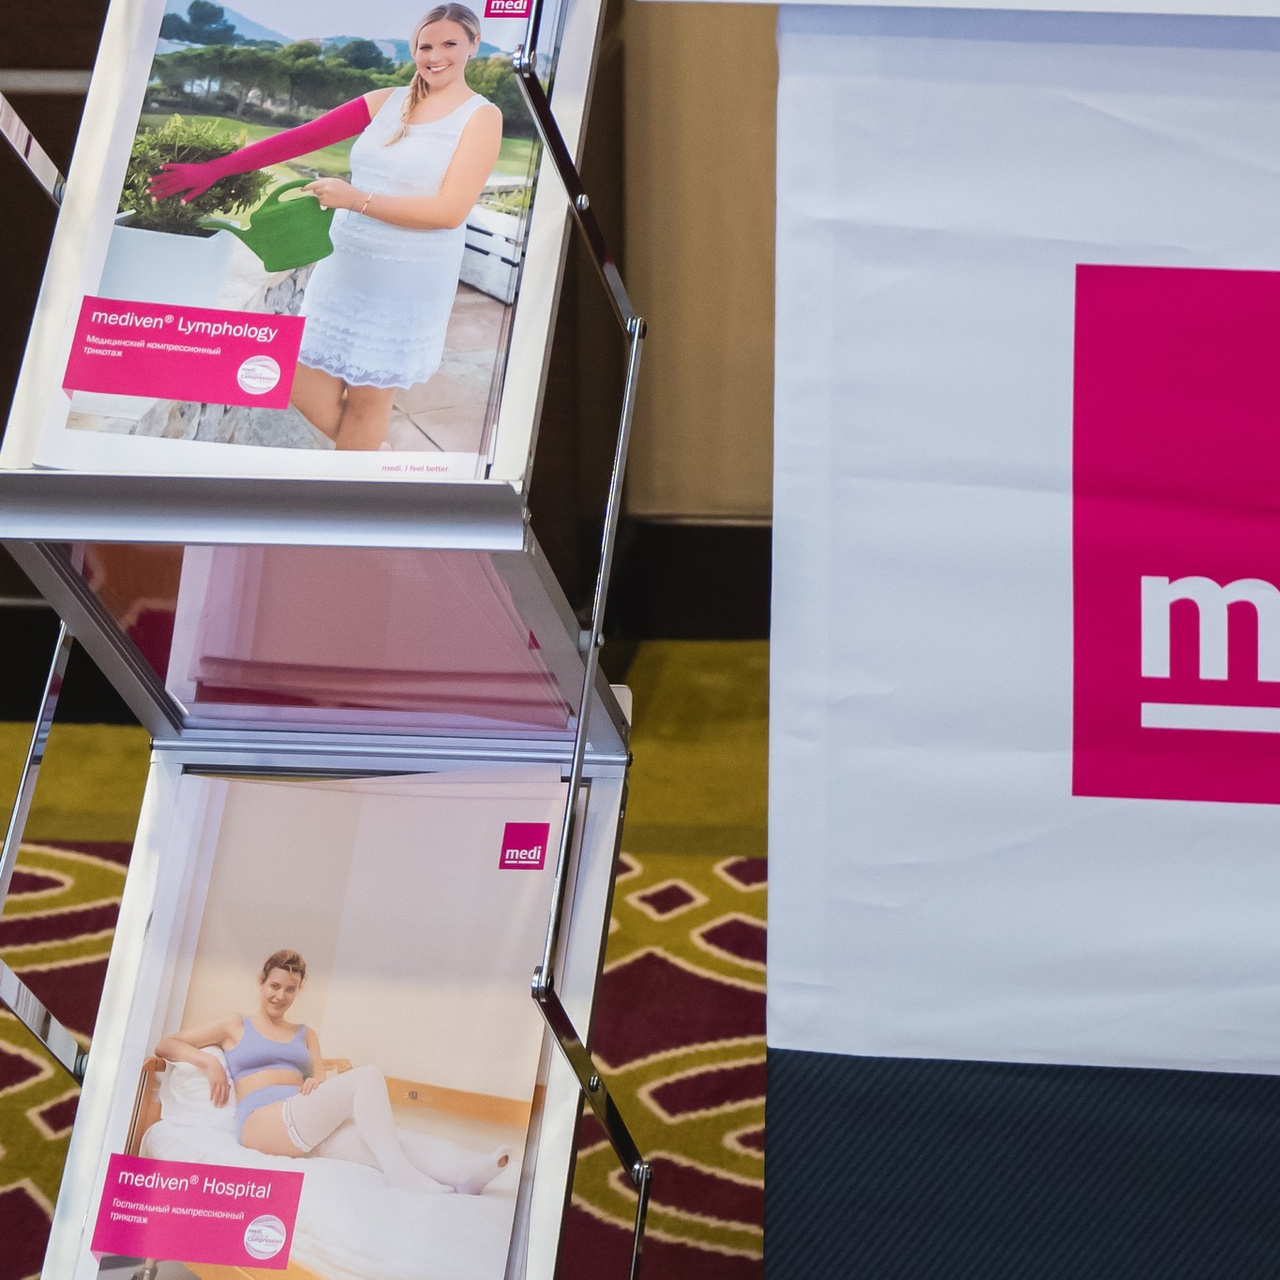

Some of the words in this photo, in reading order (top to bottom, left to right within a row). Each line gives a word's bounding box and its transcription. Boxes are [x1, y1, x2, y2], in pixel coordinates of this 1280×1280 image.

[91, 310, 175, 330] mediven®
[177, 316, 279, 343] Lymphology
[83, 346, 123, 358] трикотаж
[85, 334, 146, 349] Медицинский
[146, 340, 222, 356] компрессионный
[505, 845, 542, 860] medi
[118, 1170, 200, 1191] mediven®
[202, 1176, 272, 1200] Hospital
[110, 1211, 149, 1225] трикотаж
[112, 1197, 171, 1213] Госпитальный
[171, 1206, 245, 1222] компрессионный
